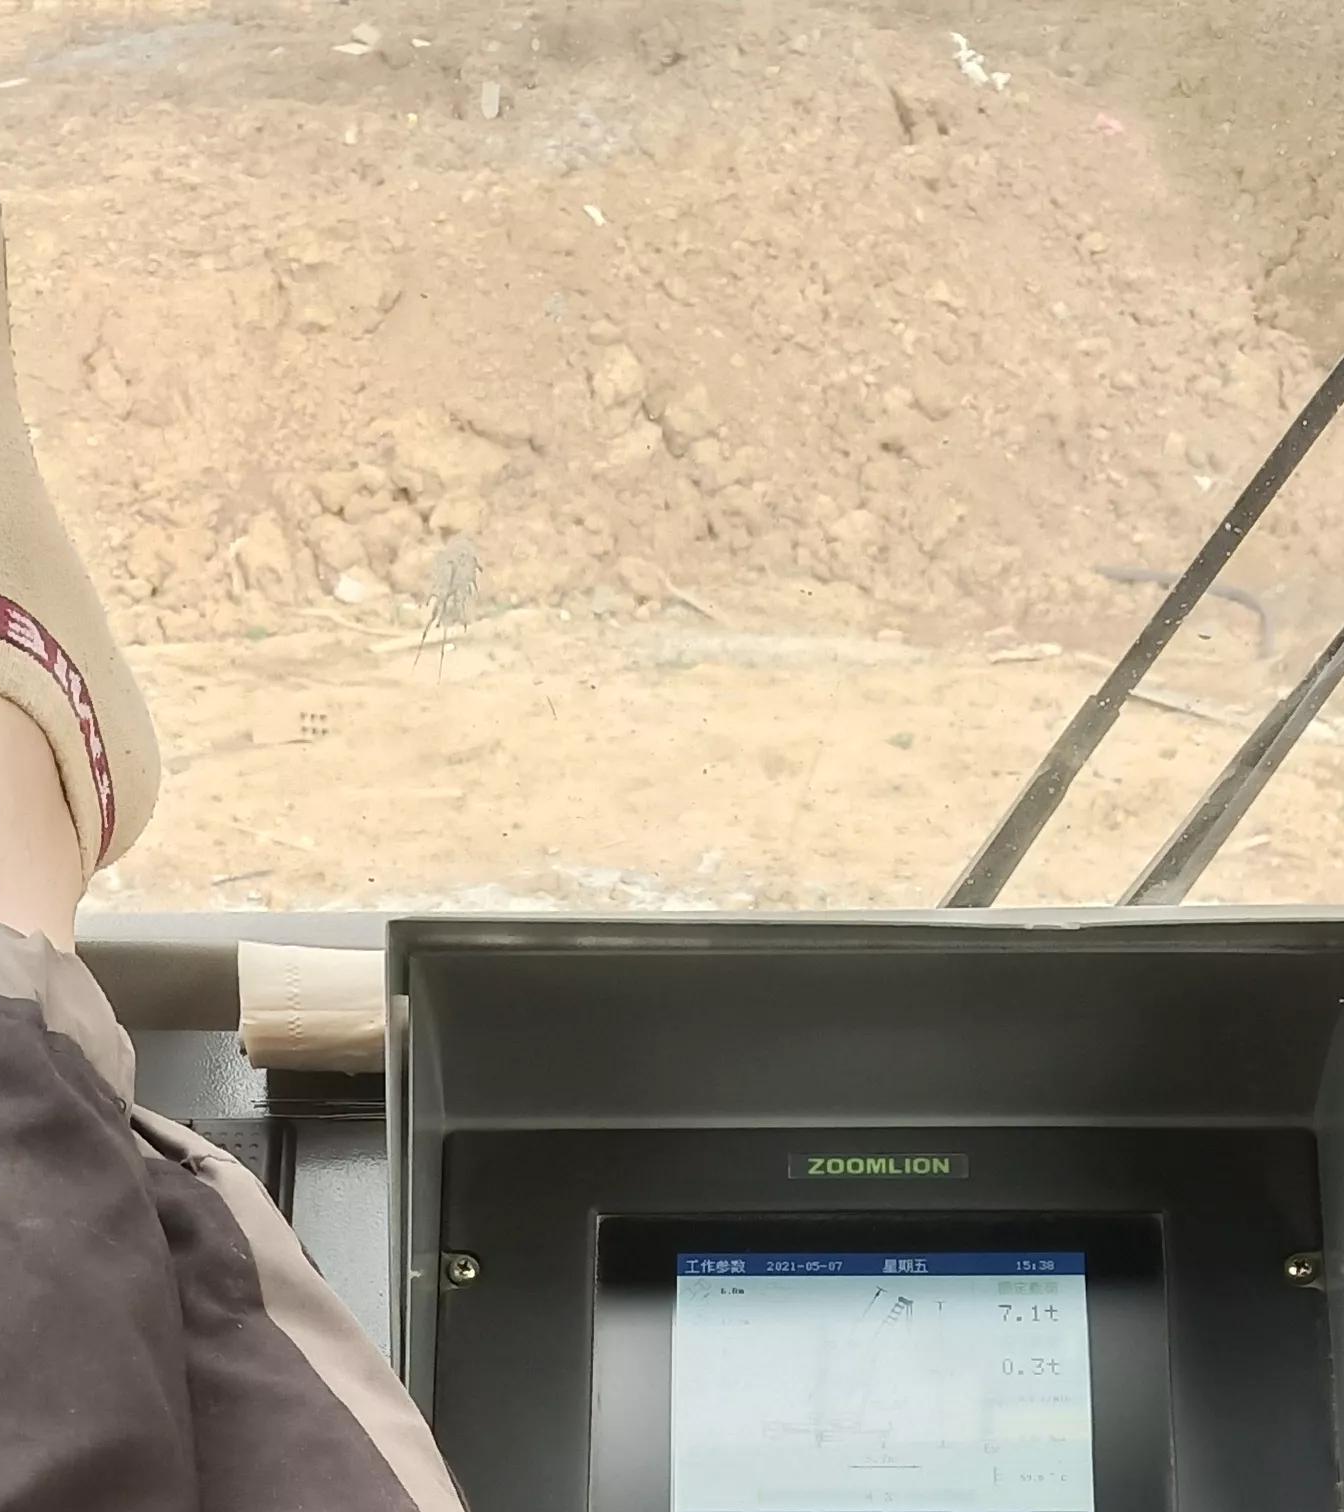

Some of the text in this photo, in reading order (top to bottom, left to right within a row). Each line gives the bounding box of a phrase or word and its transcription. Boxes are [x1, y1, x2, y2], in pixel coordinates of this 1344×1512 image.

[807, 1157, 950, 1175] ZOOMLION
[684, 1258, 1055, 1274] 工作参数 2021-05-07 星期五 15:38
[998, 1304, 1059, 1322] 7.1t
[1002, 1358, 1060, 1376] 0.3t
